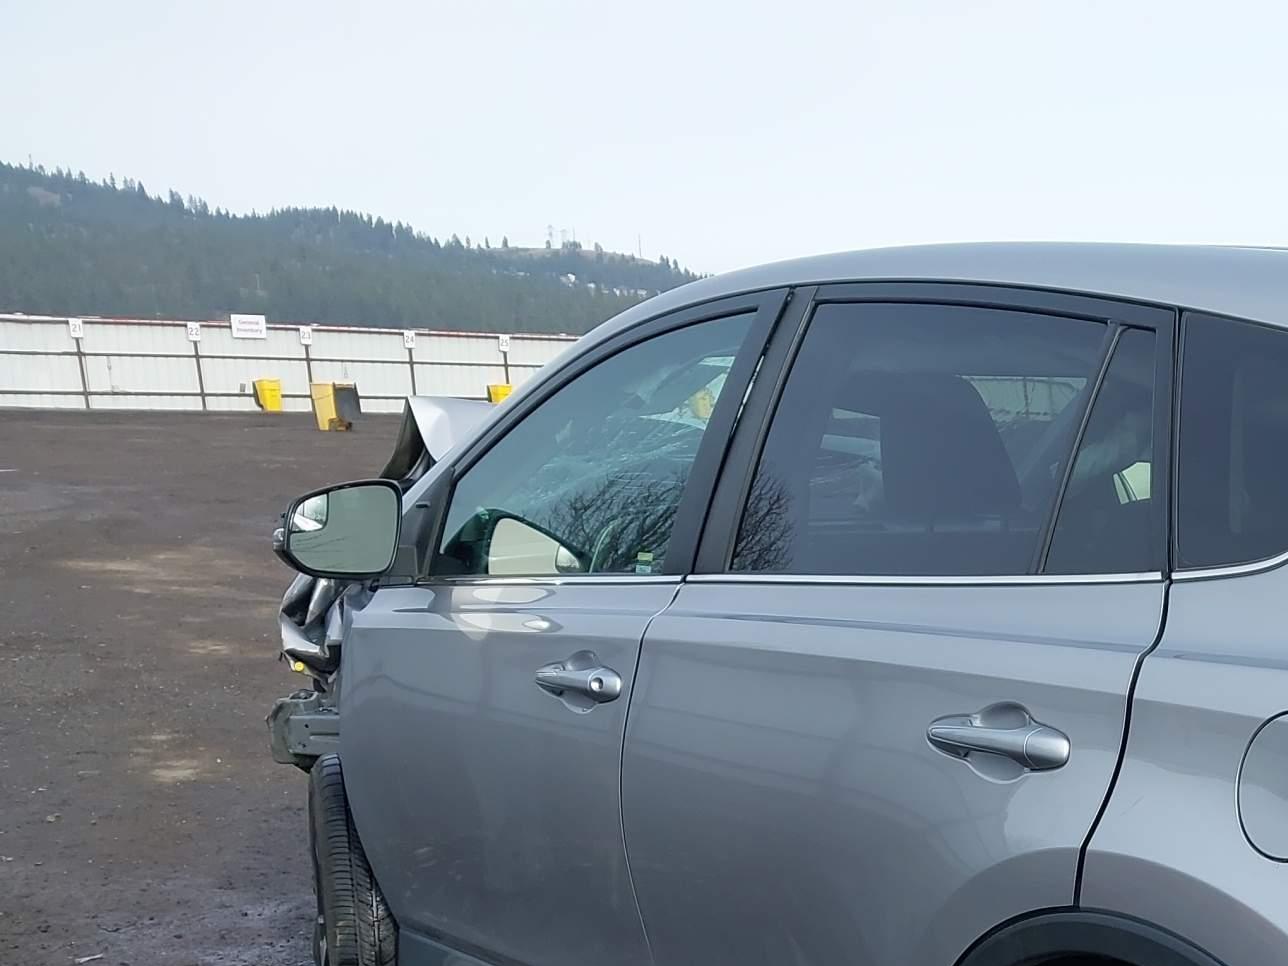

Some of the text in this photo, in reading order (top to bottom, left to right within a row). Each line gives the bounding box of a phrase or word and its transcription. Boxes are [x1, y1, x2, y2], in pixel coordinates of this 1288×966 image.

[72, 323, 81, 332] 21
[188, 327, 200, 336] 22
[301, 331, 311, 339] 23
[405, 335, 415, 343] 24
